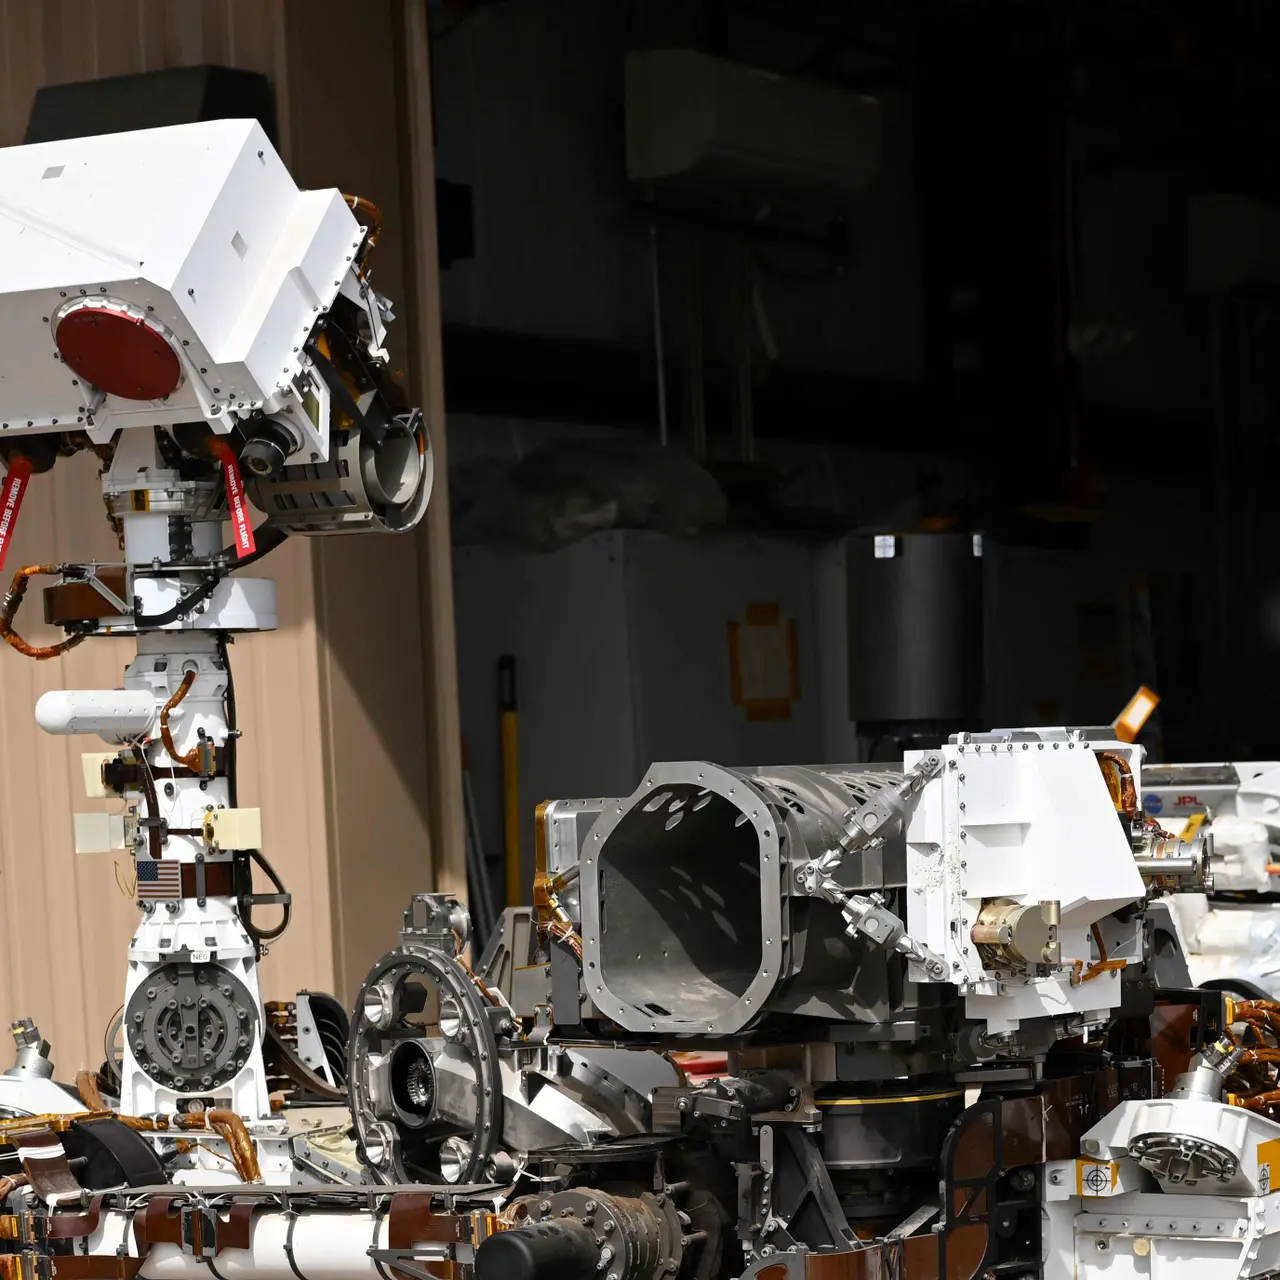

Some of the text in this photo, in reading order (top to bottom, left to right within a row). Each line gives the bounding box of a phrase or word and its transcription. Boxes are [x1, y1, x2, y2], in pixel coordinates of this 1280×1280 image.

[6, 477, 22, 508] REMOVE
[227, 464, 250, 549] REMOVE BEFORE FLIGHT
[1173, 795, 1204, 806] JPL
